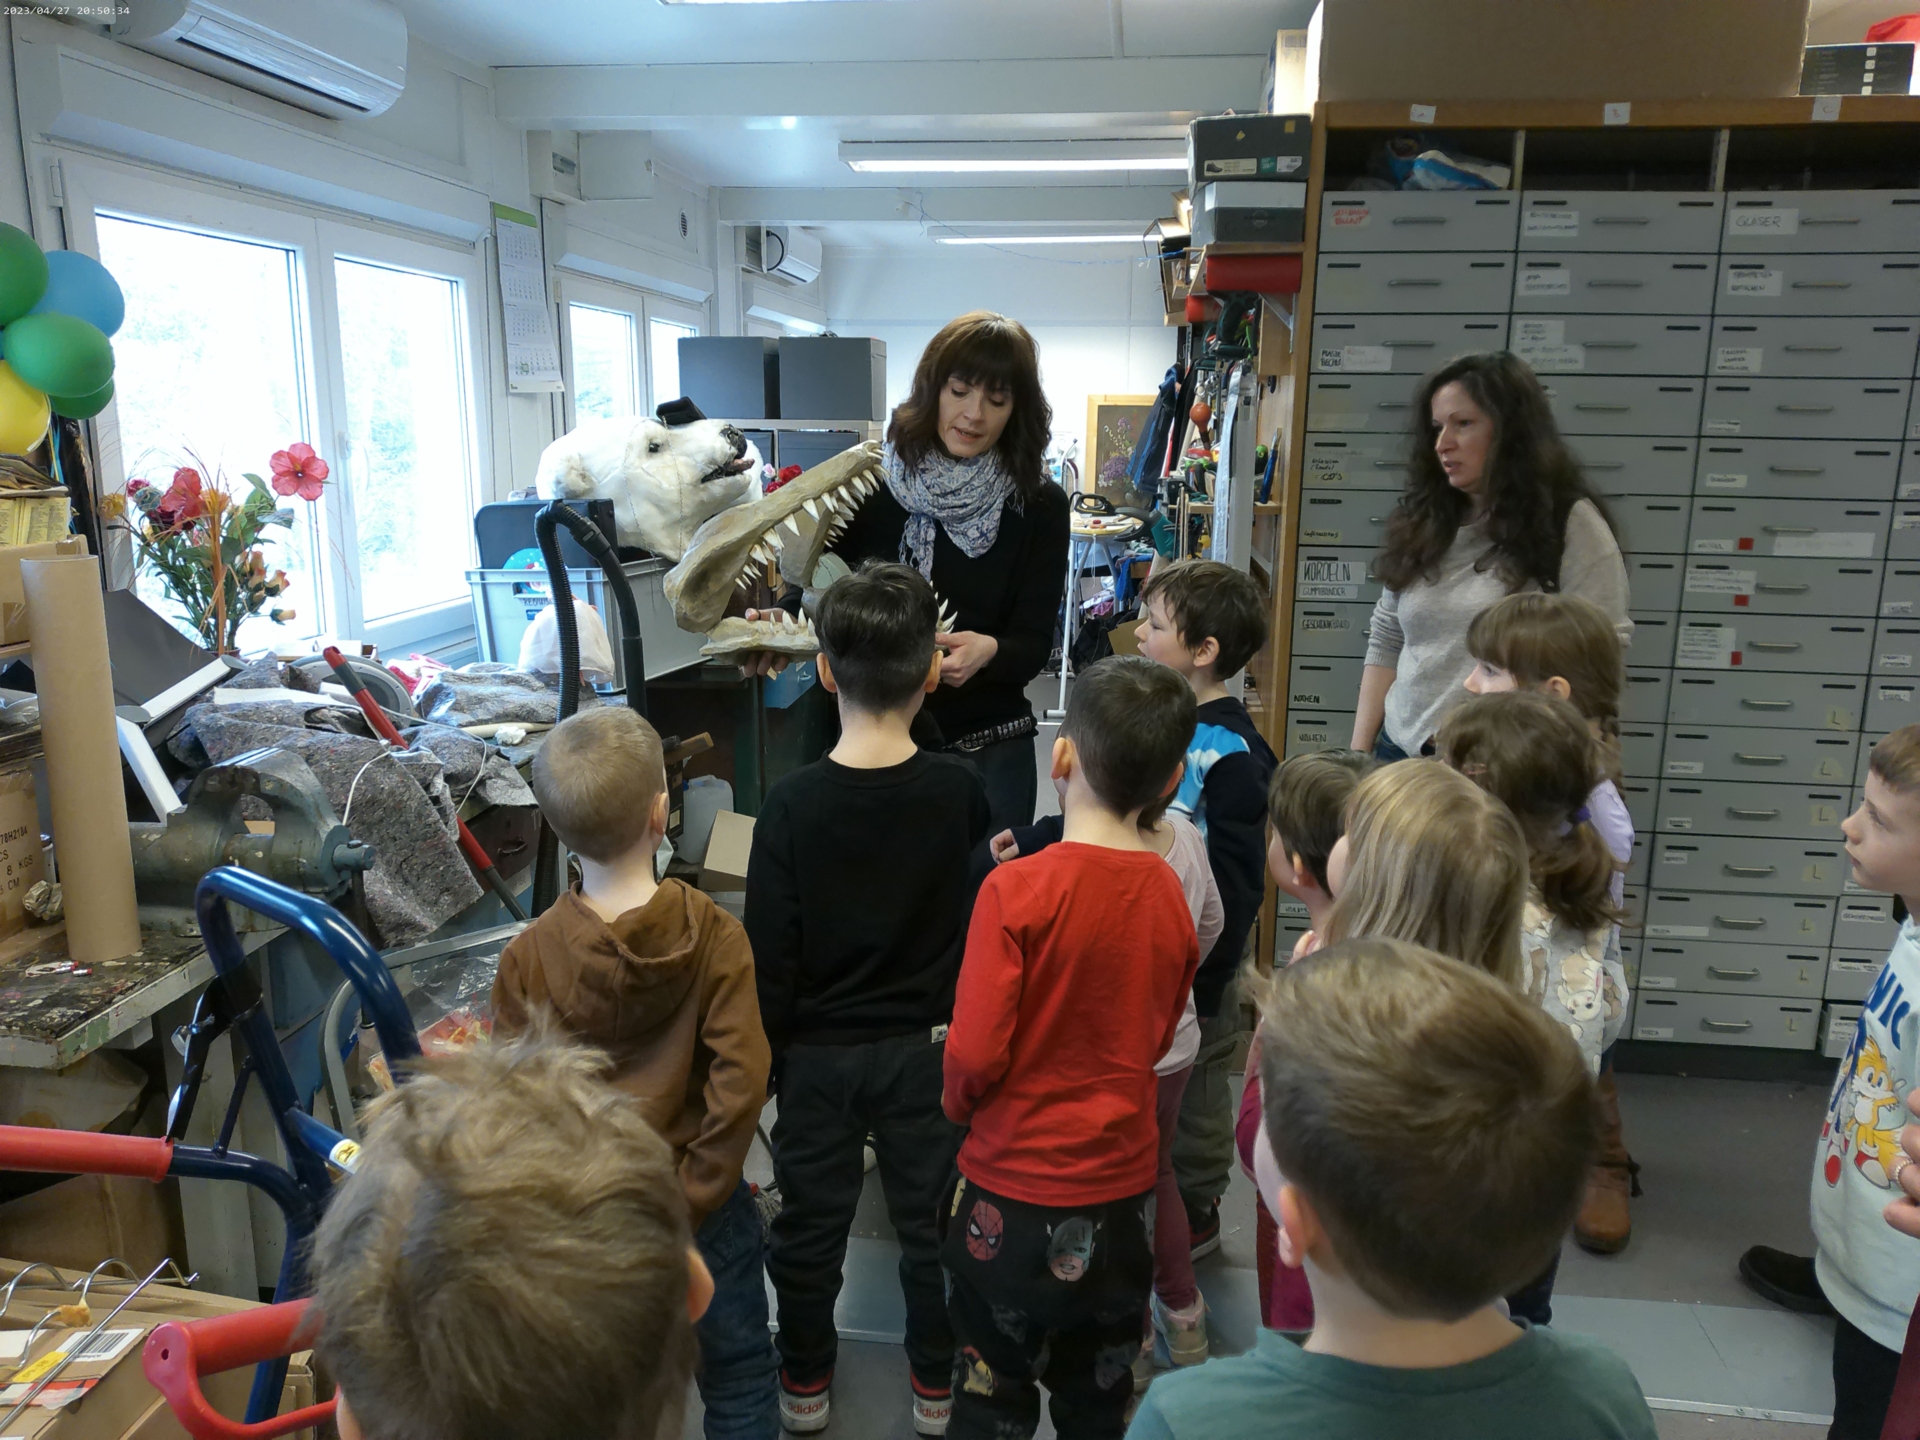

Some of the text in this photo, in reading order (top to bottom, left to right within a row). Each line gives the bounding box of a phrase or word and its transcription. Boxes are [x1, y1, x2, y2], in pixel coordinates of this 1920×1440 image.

[1303, 561, 1351, 582] KORDELN
[6, 854, 34, 876] 8 KGS
[7, 877, 20, 891] CM
[787, 1401, 824, 1415] adidas
